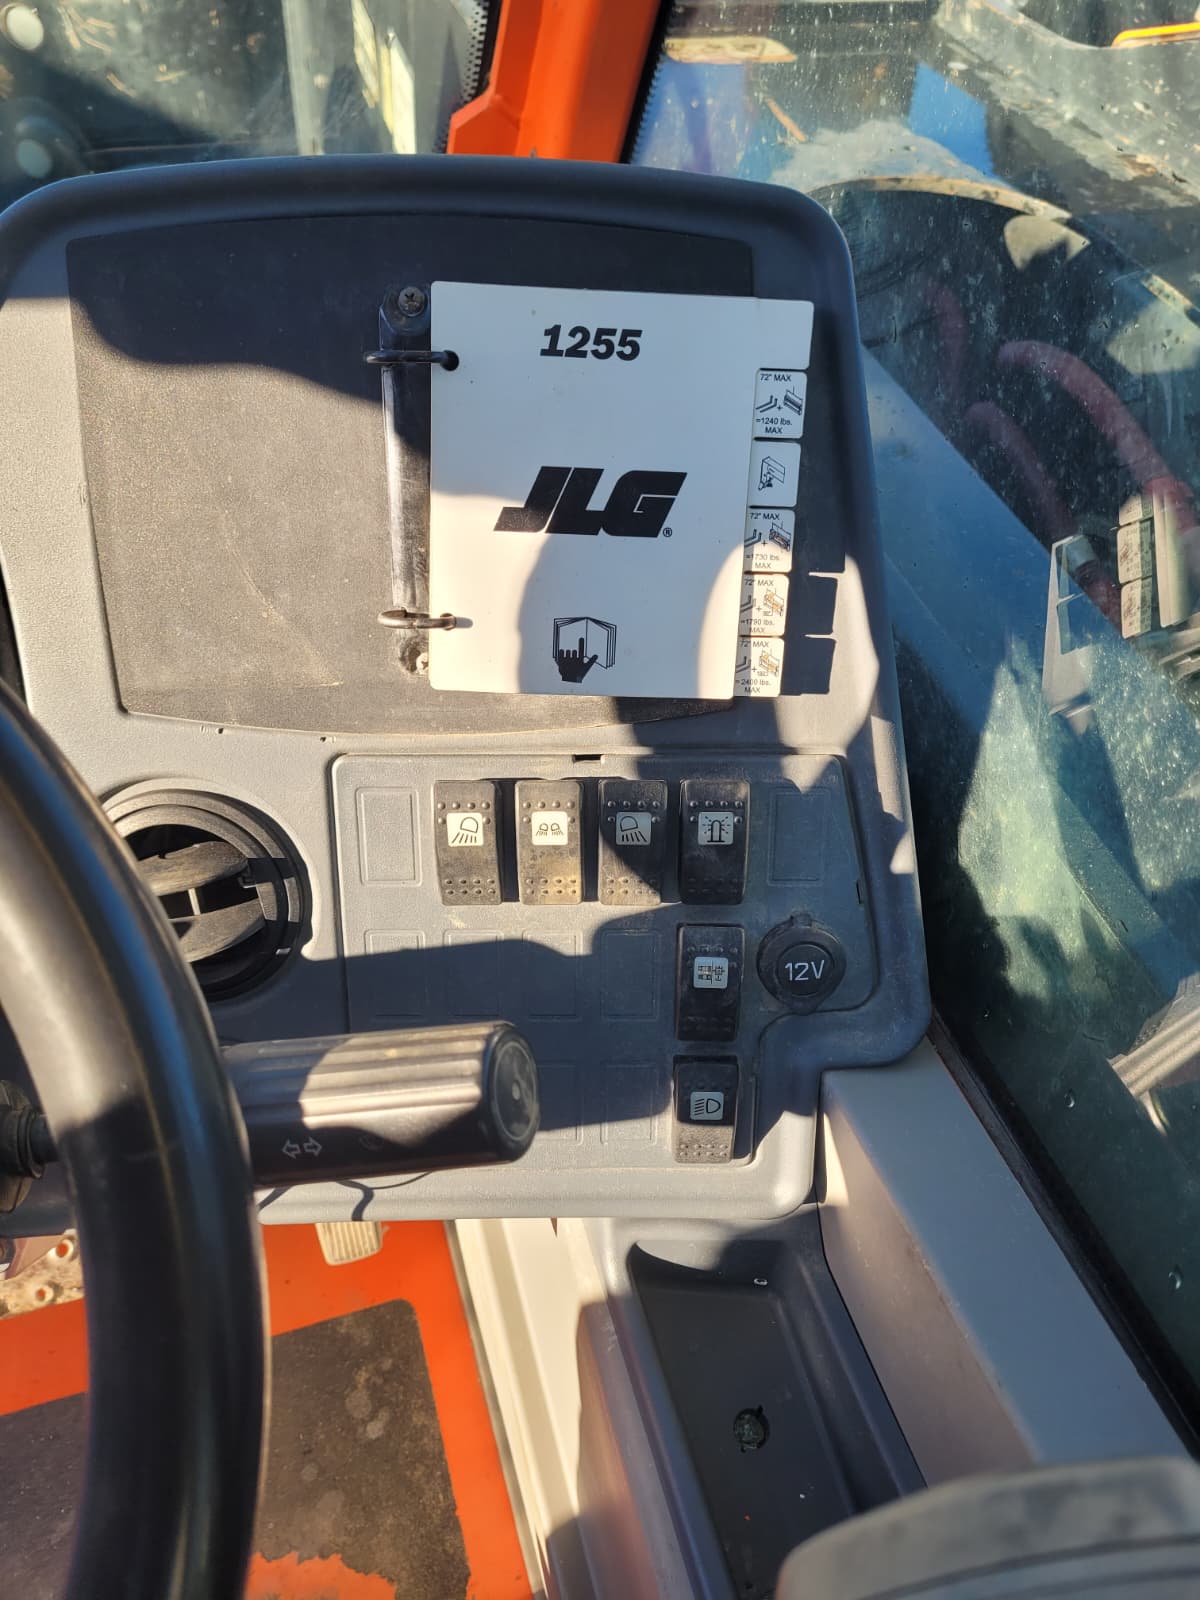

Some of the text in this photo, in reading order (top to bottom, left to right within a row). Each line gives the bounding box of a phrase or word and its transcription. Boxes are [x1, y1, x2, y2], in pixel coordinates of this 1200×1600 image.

[540, 324, 643, 361] 1255
[774, 373, 792, 382] MAX
[780, 417, 793, 426] lbs.
[765, 426, 783, 434] MAX
[763, 513, 780, 521] MAX
[752, 640, 769, 648] MAX
[744, 685, 761, 693] MAX
[785, 959, 825, 982] 12V
